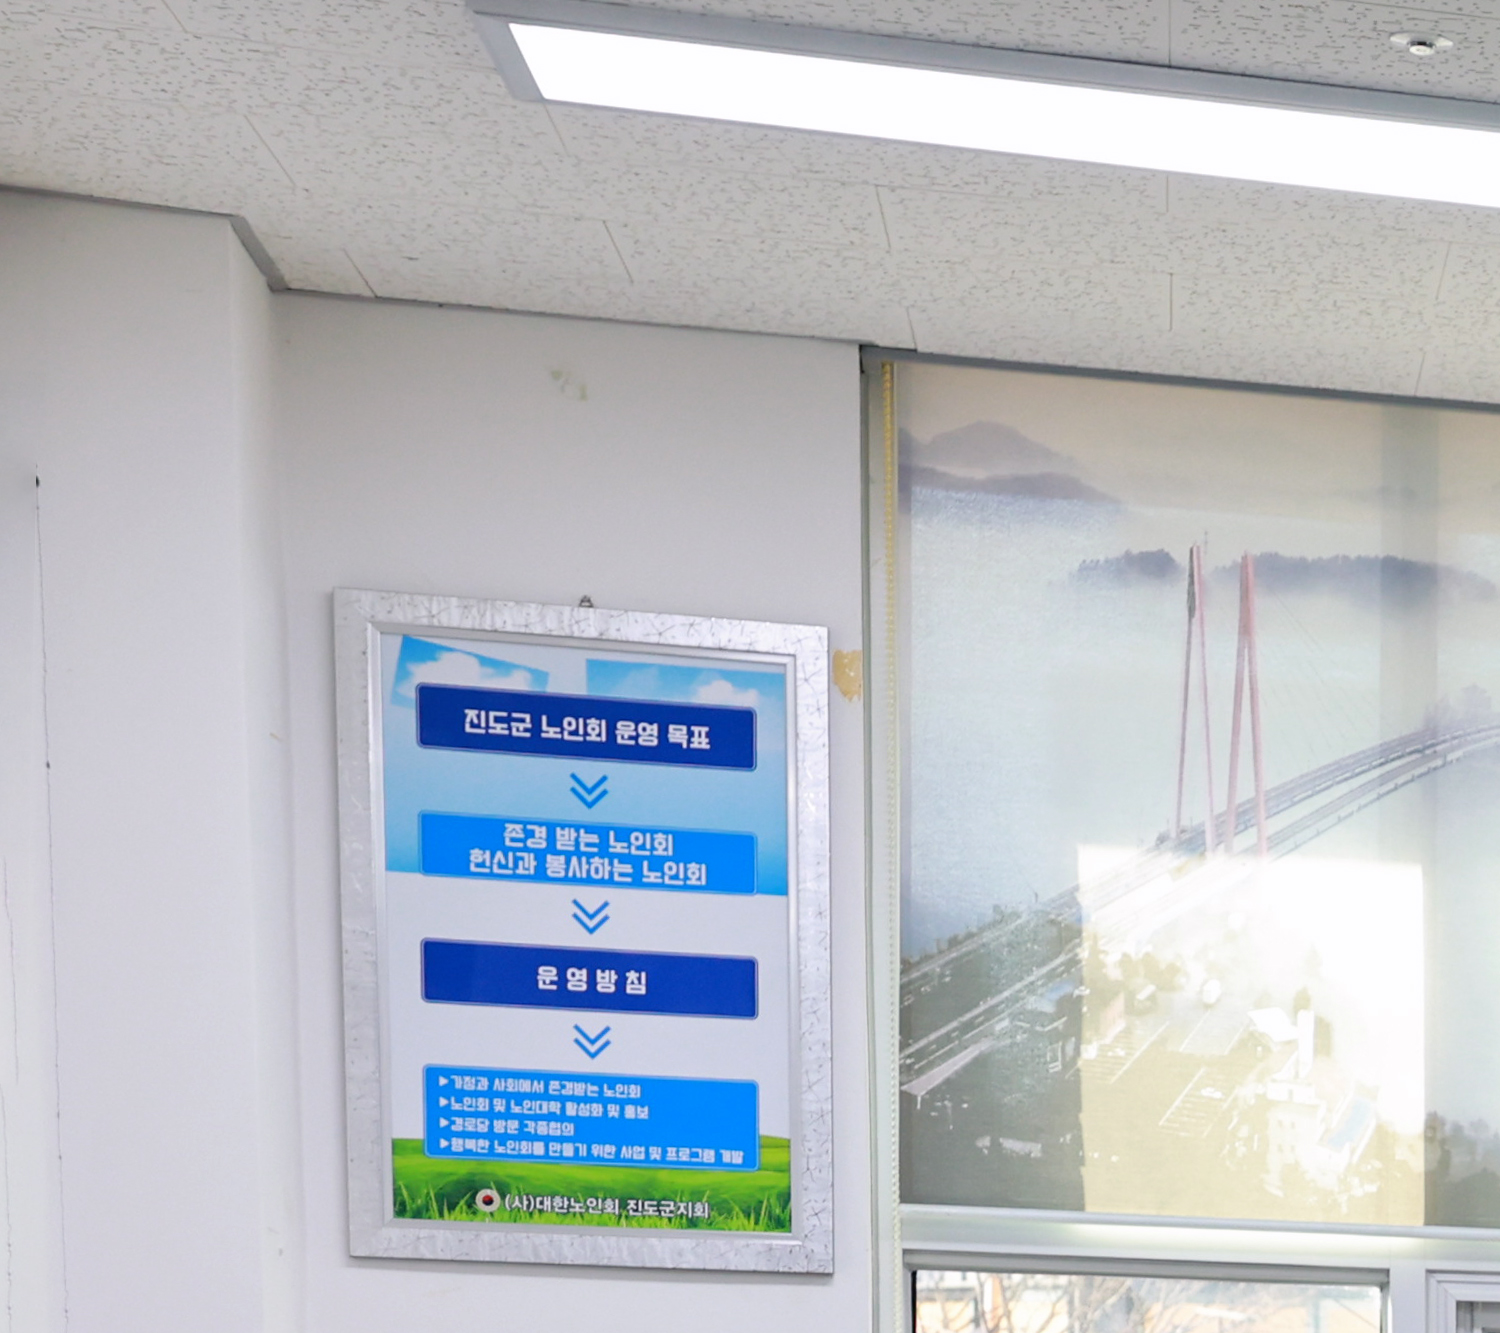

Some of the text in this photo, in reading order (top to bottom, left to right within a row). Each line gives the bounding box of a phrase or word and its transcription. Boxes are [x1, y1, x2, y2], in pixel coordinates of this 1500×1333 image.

[465, 709, 709, 749] 진도군 노인회 운영 목표
[504, 823, 672, 856] 존경 받는 노인회
[469, 848, 705, 886] 헌신과 봉사하는 노인회
[452, 1075, 640, 1098] 가정과 사회에서 존경받는 노인회
[451, 1096, 648, 1119] 노인회 및 노인대학 활성화 및 홍보
[450, 1116, 489, 1132] 경로당
[493, 1119, 518, 1133] 방문
[451, 1137, 743, 1164] 행복한 노인회를 만들기 위한 사업 및 프로그램 개발
[505, 1194, 707, 1218] (사)대한노인회 진도군지회
